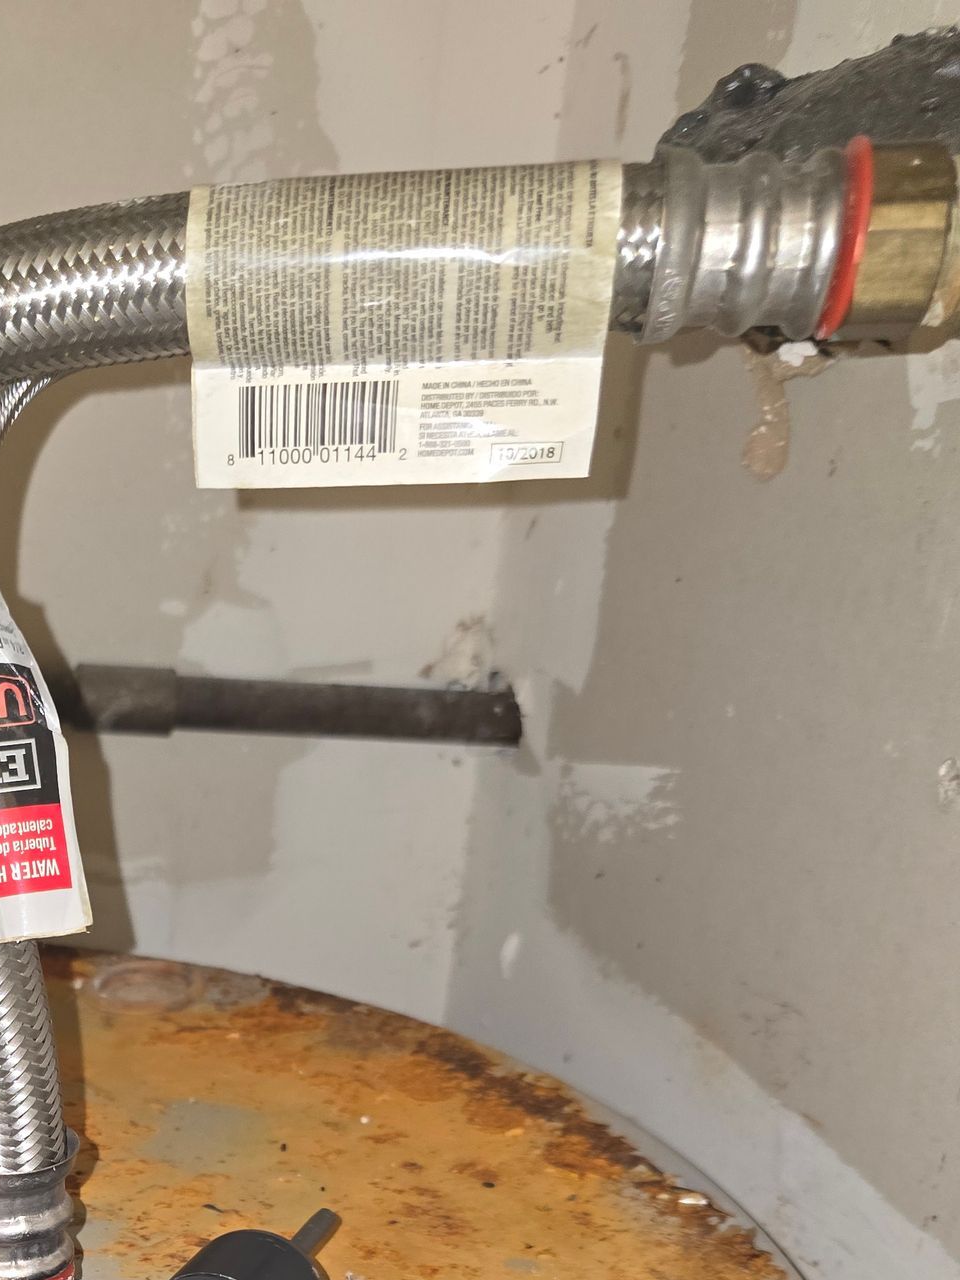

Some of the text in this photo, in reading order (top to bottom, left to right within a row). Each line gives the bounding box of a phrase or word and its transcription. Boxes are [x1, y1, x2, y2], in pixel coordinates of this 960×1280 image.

[422, 381, 442, 390] MADE
[442, 381, 450, 389] IN
[450, 381, 472, 389] CHINA
[476, 379, 500, 388] HECHO
[510, 378, 532, 387] CHINA
[227, 445, 408, 466] 8 11000 01144 2
[11, 833, 56, 857] Tubería
[9, 855, 59, 882] WATER
